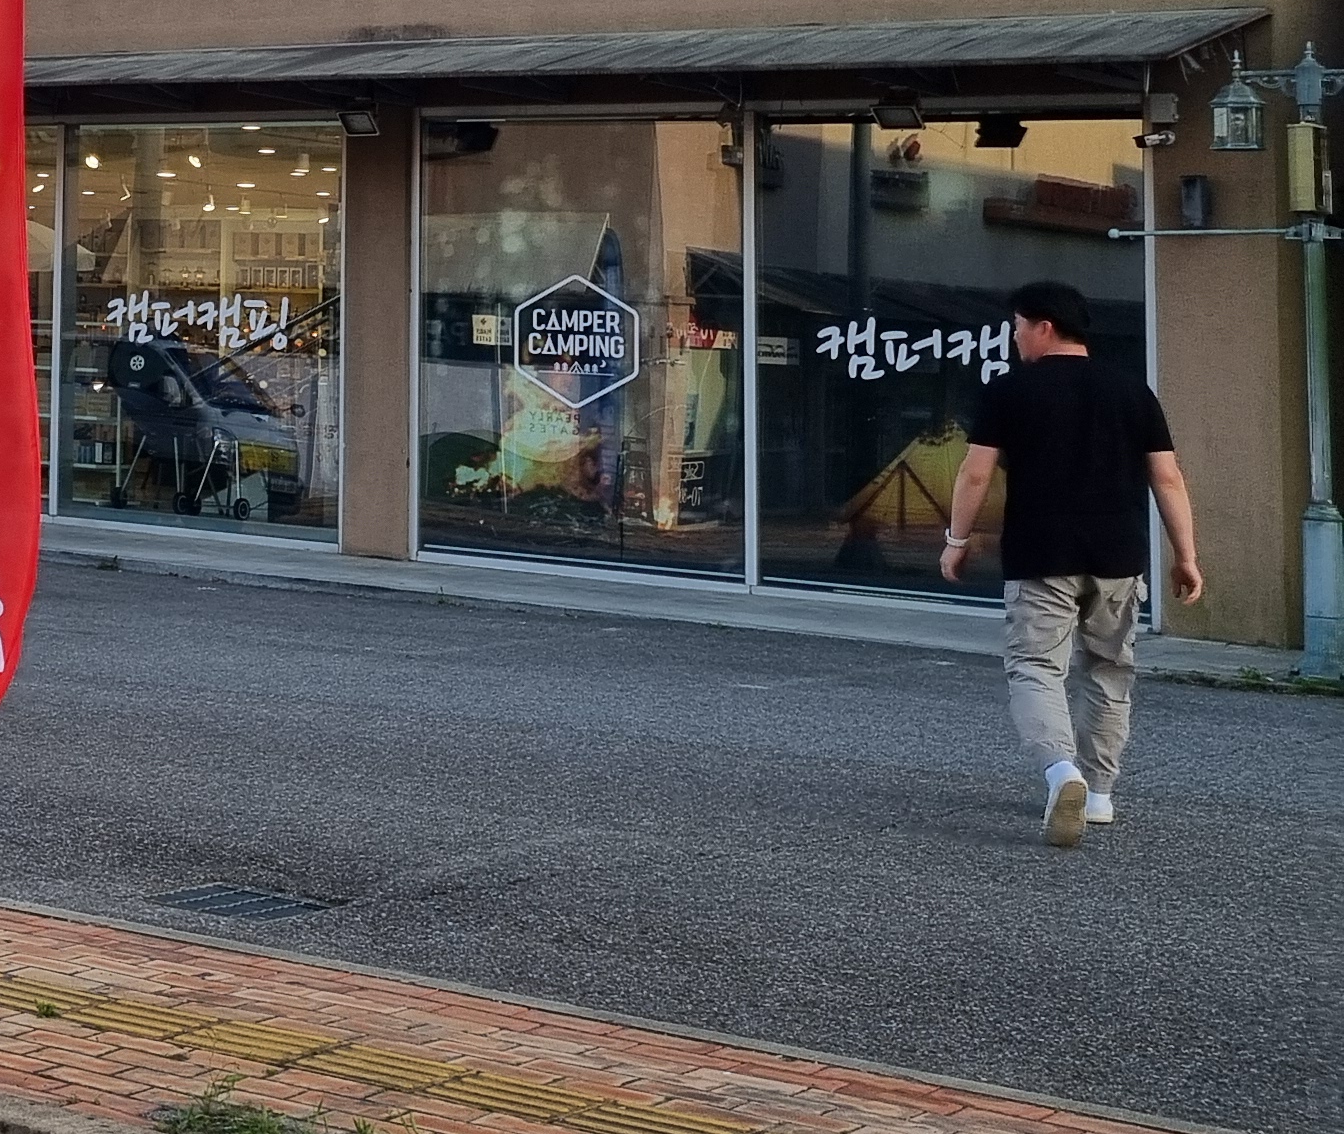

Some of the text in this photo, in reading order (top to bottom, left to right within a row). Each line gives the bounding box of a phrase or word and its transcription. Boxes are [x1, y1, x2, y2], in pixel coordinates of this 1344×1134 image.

[105, 289, 289, 351] 캠퍼캠핑
[532, 308, 621, 333] CAMPER
[527, 332, 626, 359] CAMPING
